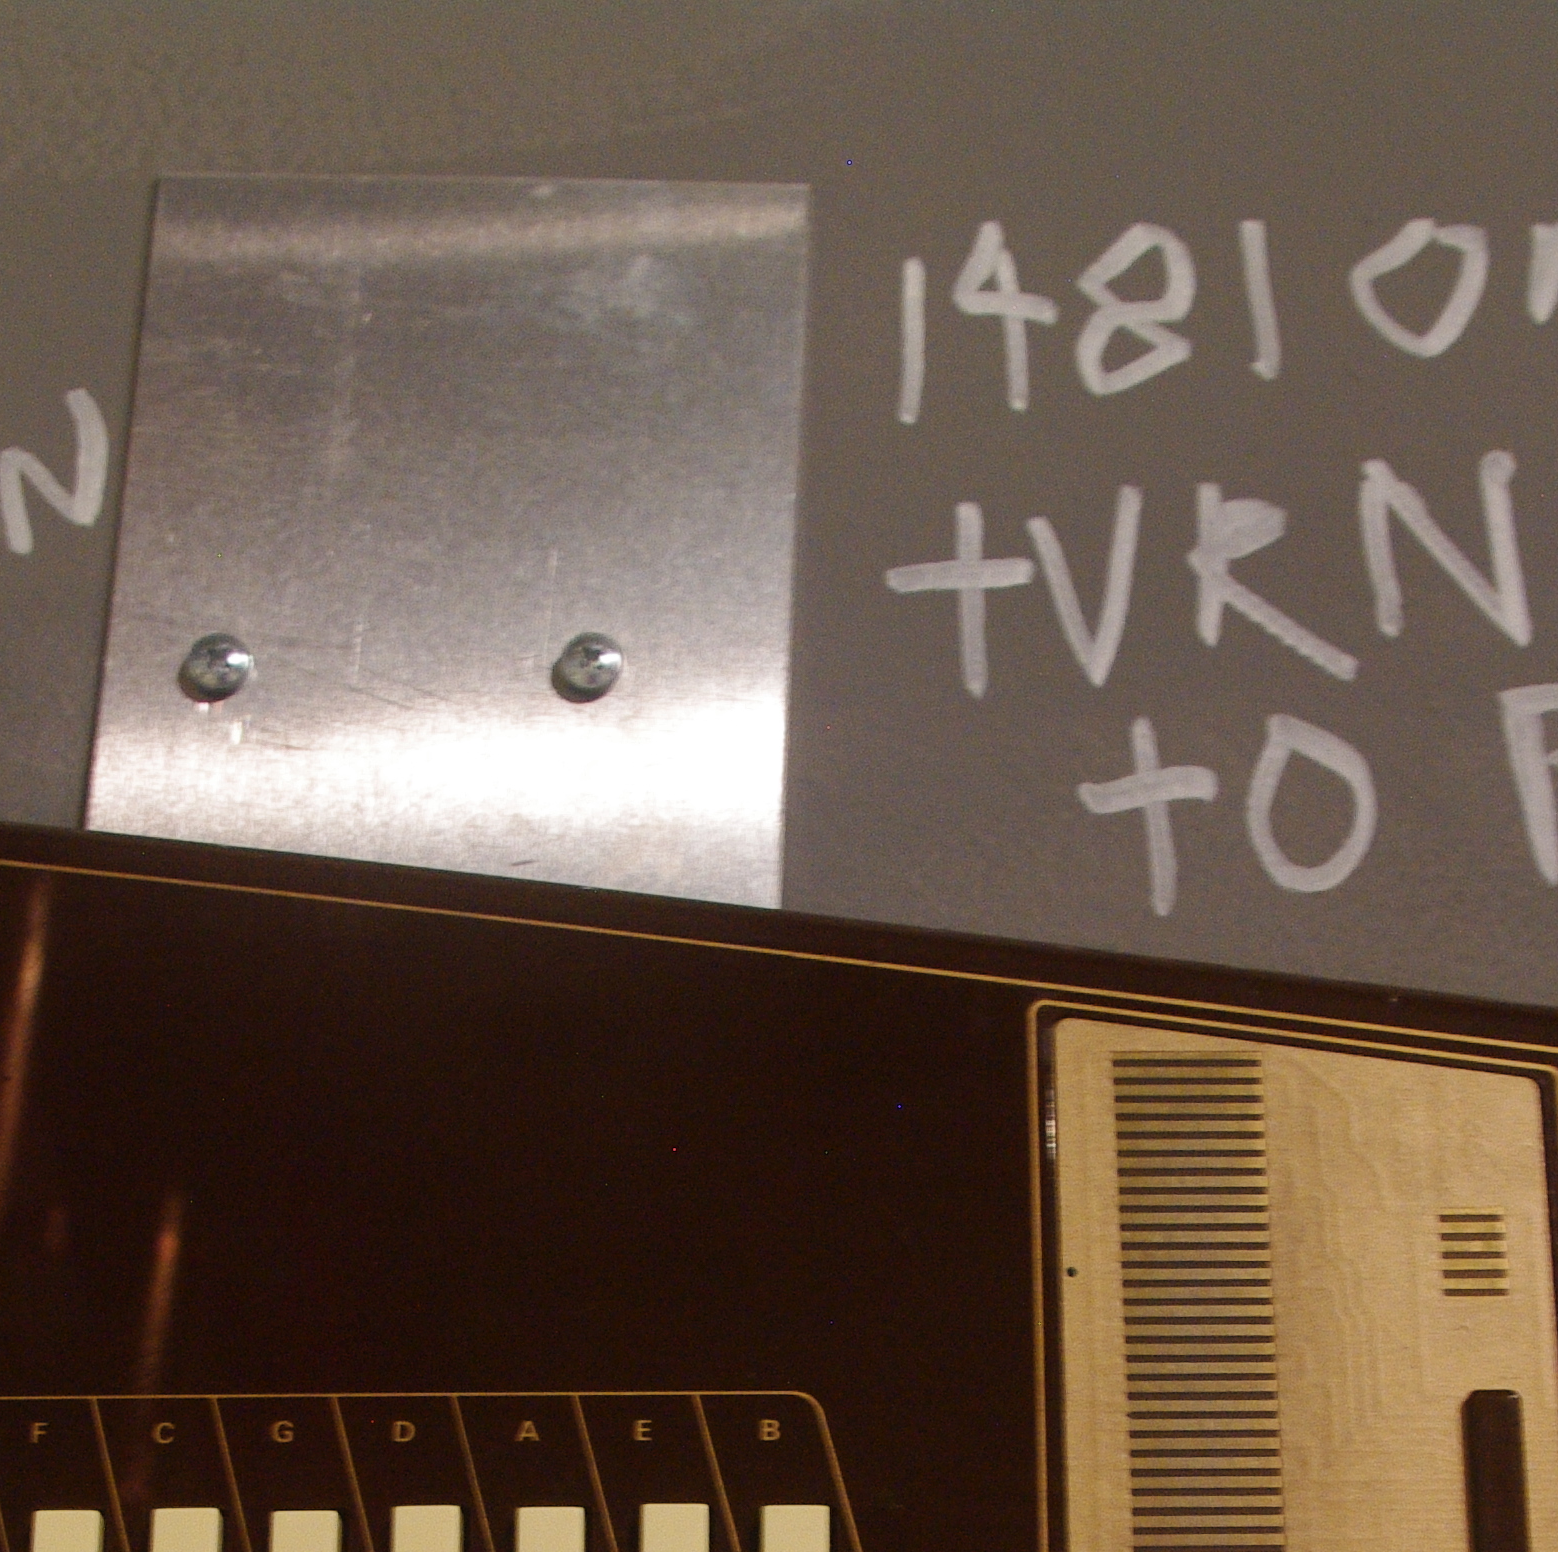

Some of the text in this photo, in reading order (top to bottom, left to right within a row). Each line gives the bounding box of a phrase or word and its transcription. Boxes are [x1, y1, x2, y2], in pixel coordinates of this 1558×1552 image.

[29, 1422, 50, 1443] F
[151, 1421, 176, 1444] C
[270, 1420, 296, 1443] G
[392, 1421, 417, 1442] D
[513, 1420, 541, 1442] A
[632, 1419, 653, 1442] E
[758, 1419, 783, 1442] B
